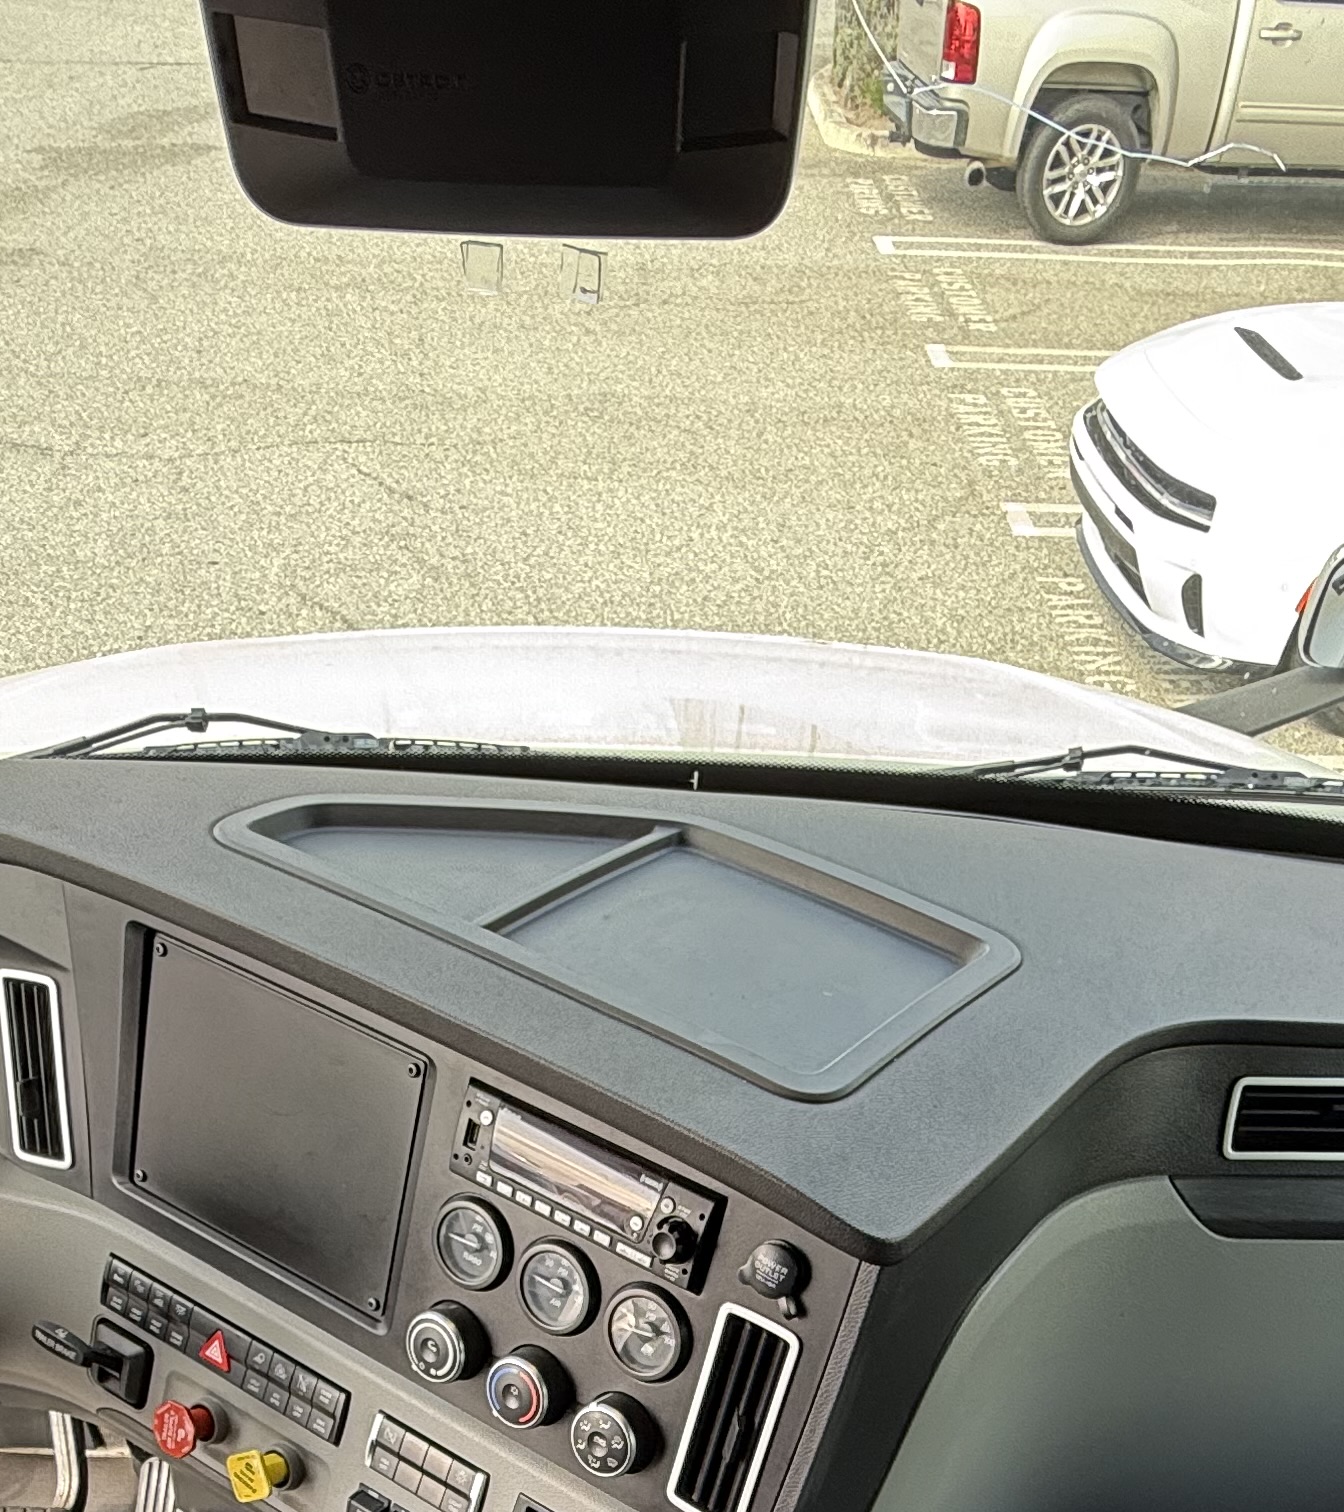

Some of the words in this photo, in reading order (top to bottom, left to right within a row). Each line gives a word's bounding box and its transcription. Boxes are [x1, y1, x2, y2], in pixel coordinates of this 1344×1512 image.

[887, 271, 946, 321] PARKING
[932, 267, 997, 332] CUSTOMER
[947, 393, 1019, 466] PARKING
[1001, 387, 1072, 479] CUSTOMER
[1035, 575, 1138, 693] PARKING
[754, 1260, 786, 1283] OUTLET
[757, 1254, 788, 1276] POWER
